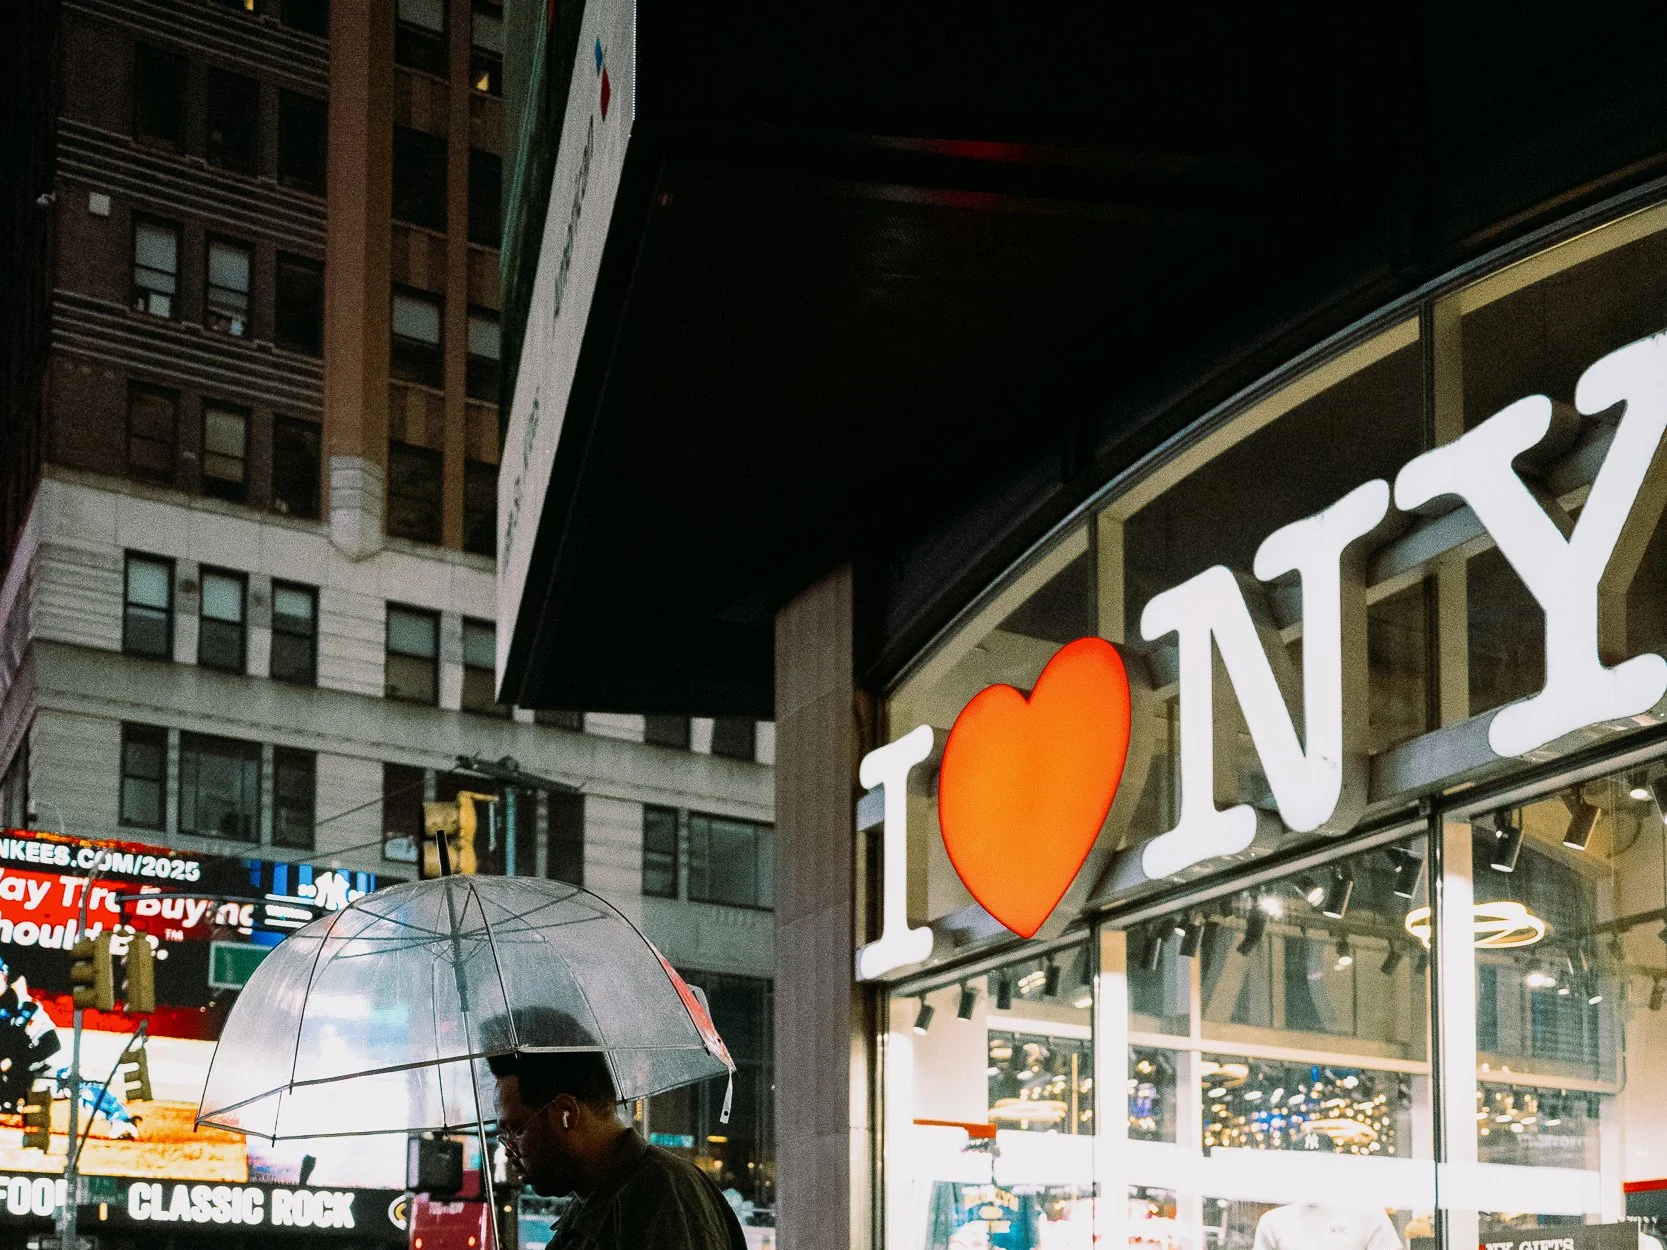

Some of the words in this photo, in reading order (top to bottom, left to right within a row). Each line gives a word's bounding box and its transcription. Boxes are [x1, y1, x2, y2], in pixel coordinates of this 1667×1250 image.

[859, 724, 934, 979] I
[1141, 330, 1667, 879] NY
[0, 868, 51, 911] ay
[128, 1182, 264, 1224] CLASSIC
[271, 1188, 355, 1228] ROCK
